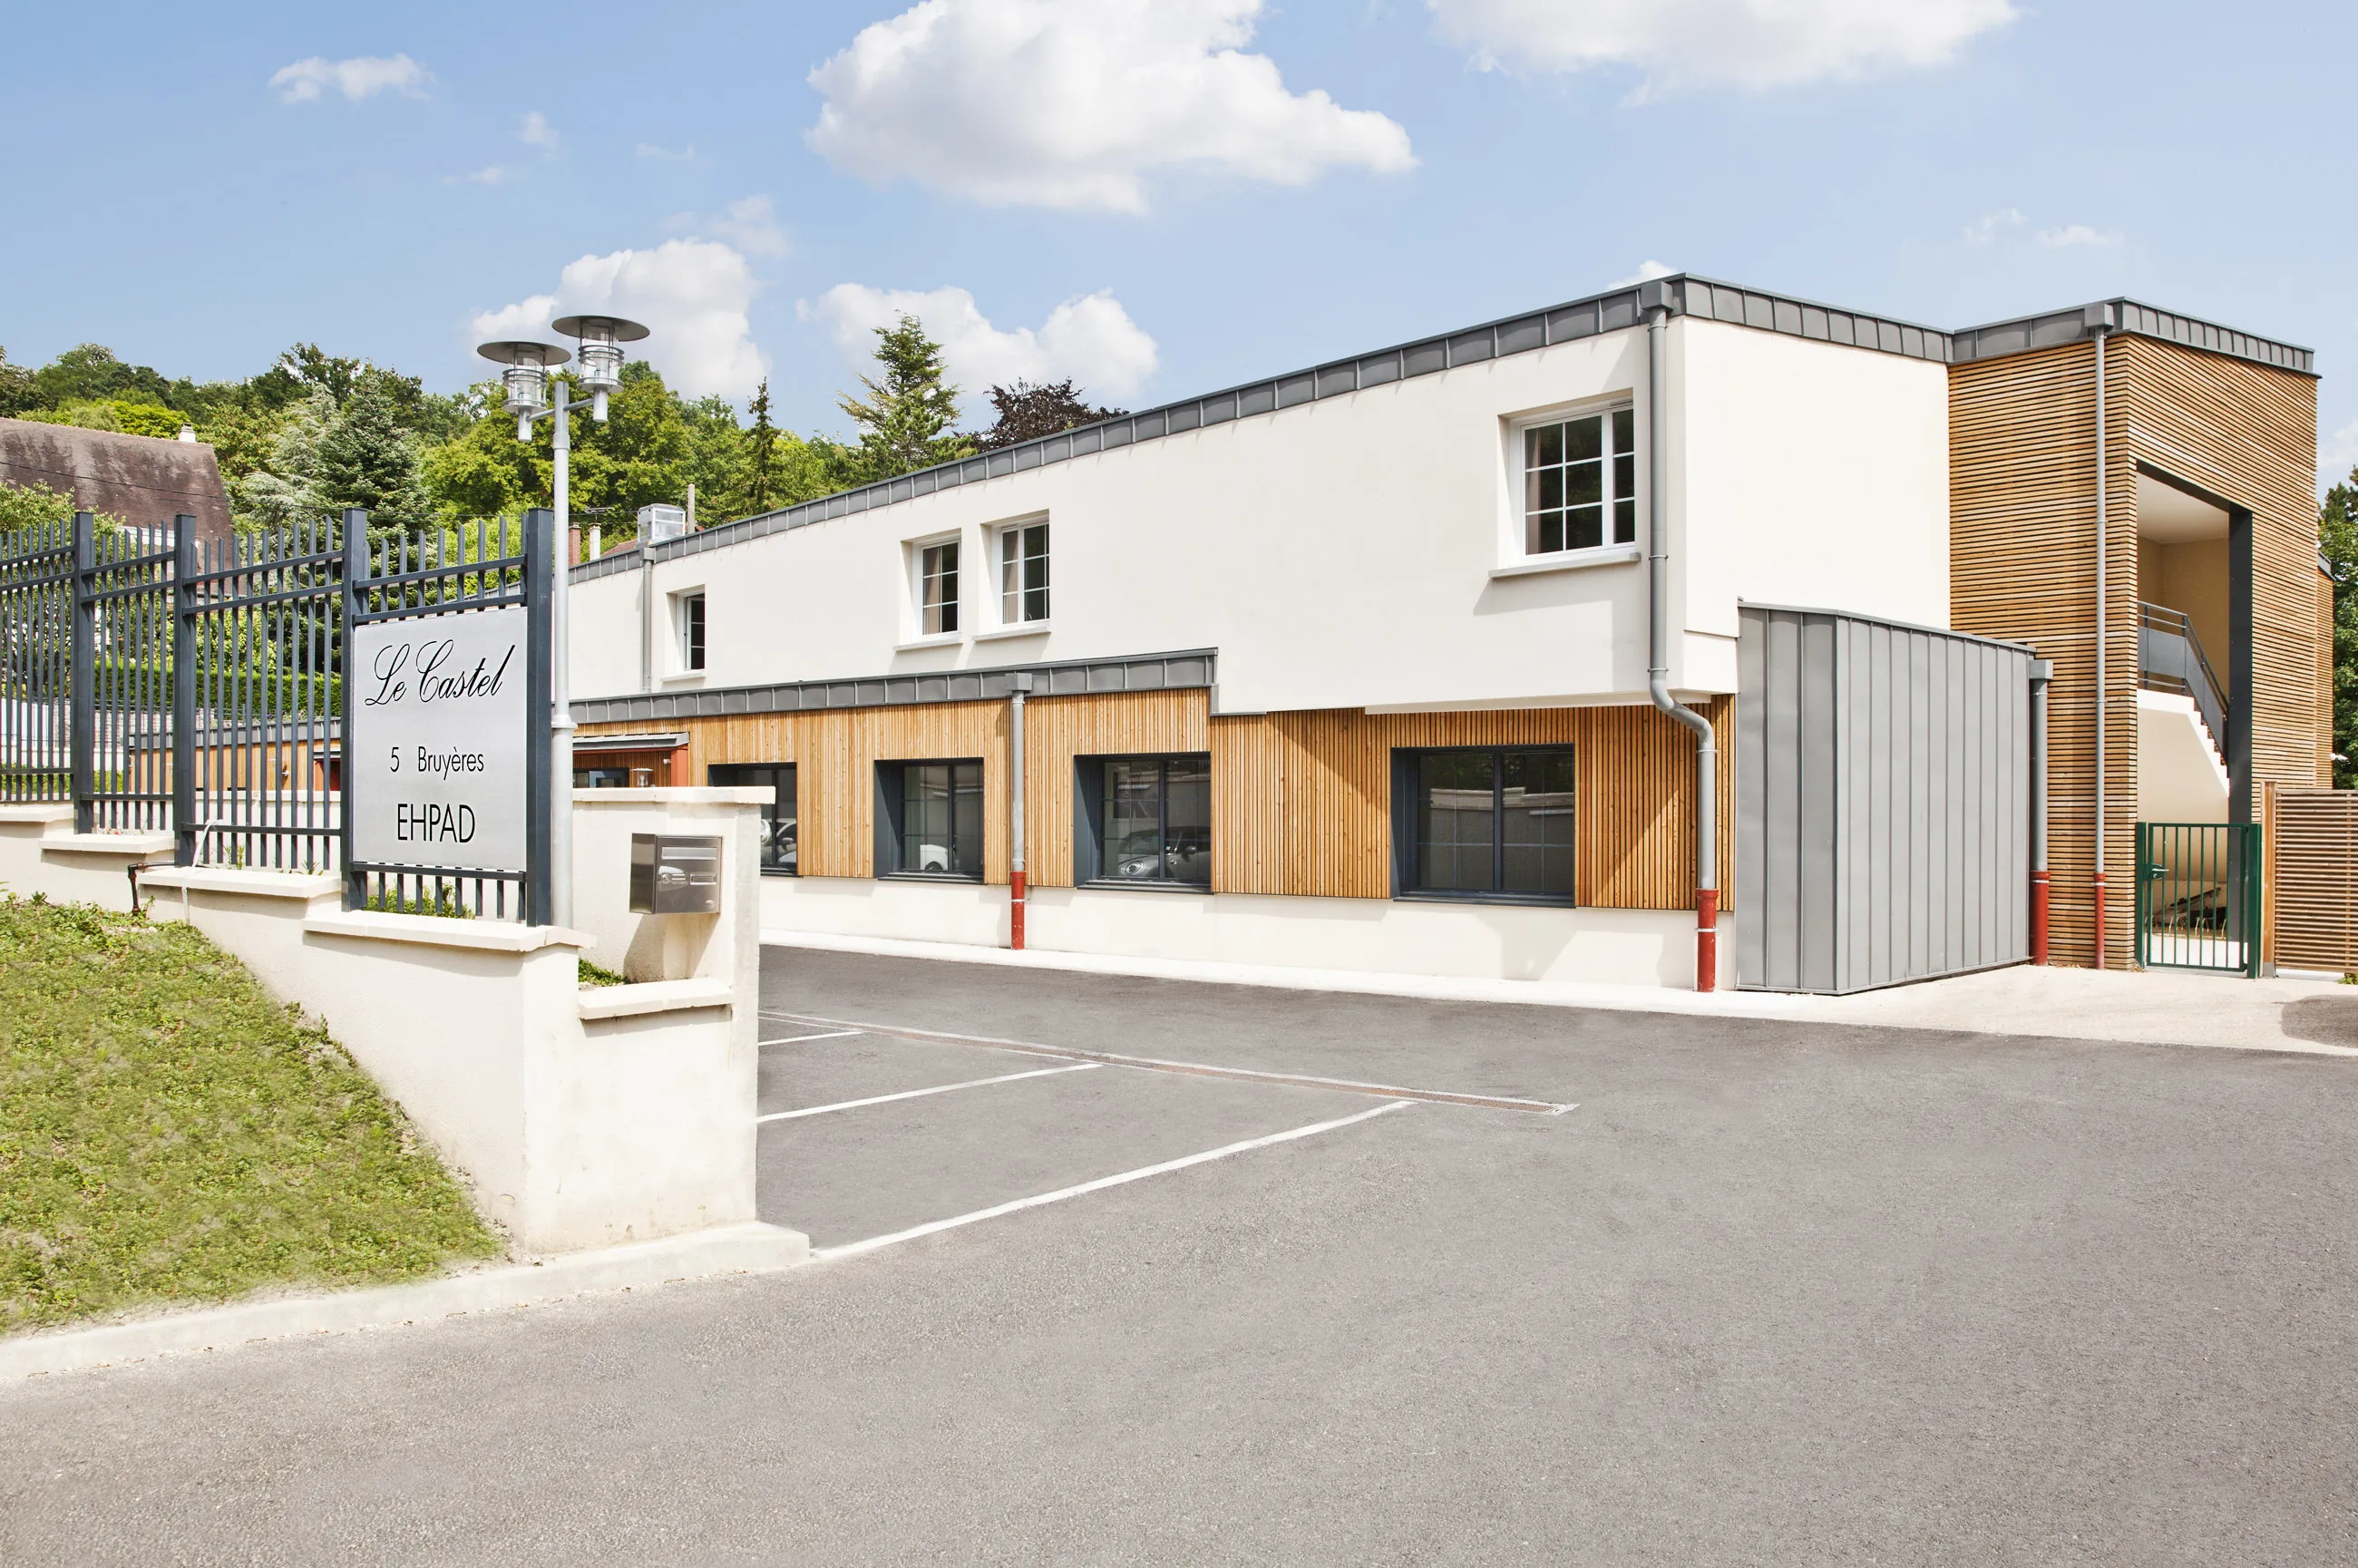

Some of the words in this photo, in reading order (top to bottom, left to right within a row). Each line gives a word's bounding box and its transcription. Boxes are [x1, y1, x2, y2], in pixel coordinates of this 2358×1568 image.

[365, 643, 411, 706] Le
[415, 638, 516, 703] Castel
[390, 746, 400, 773] 5
[418, 745, 485, 781] Bruyères
[397, 803, 476, 843] EHPAD
